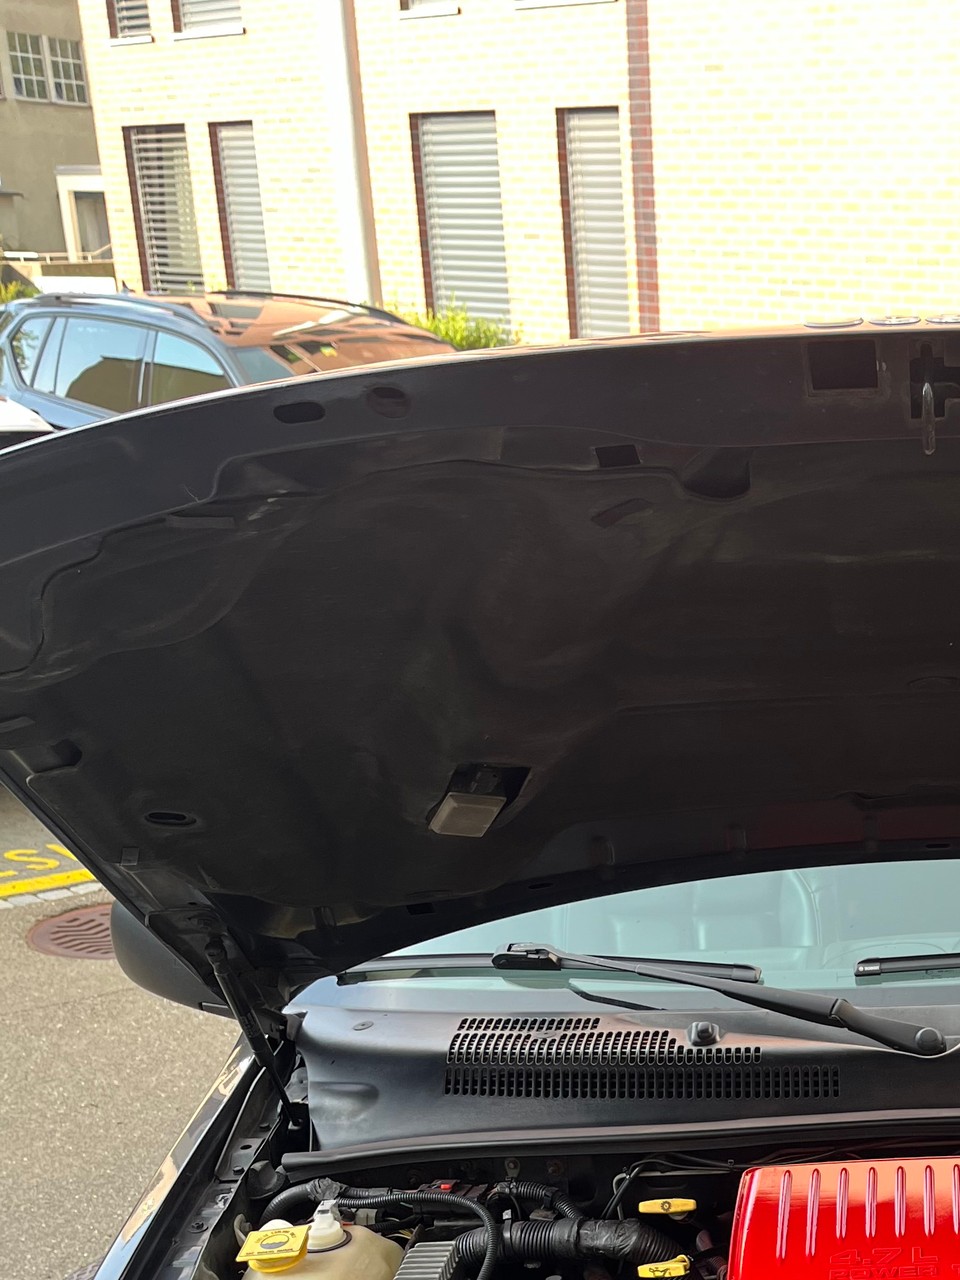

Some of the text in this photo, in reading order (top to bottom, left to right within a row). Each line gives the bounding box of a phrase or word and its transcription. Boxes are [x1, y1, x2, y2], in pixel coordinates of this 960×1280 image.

[829, 1246, 939, 1267] 4.7 L
[829, 1265, 938, 1280] POWER
